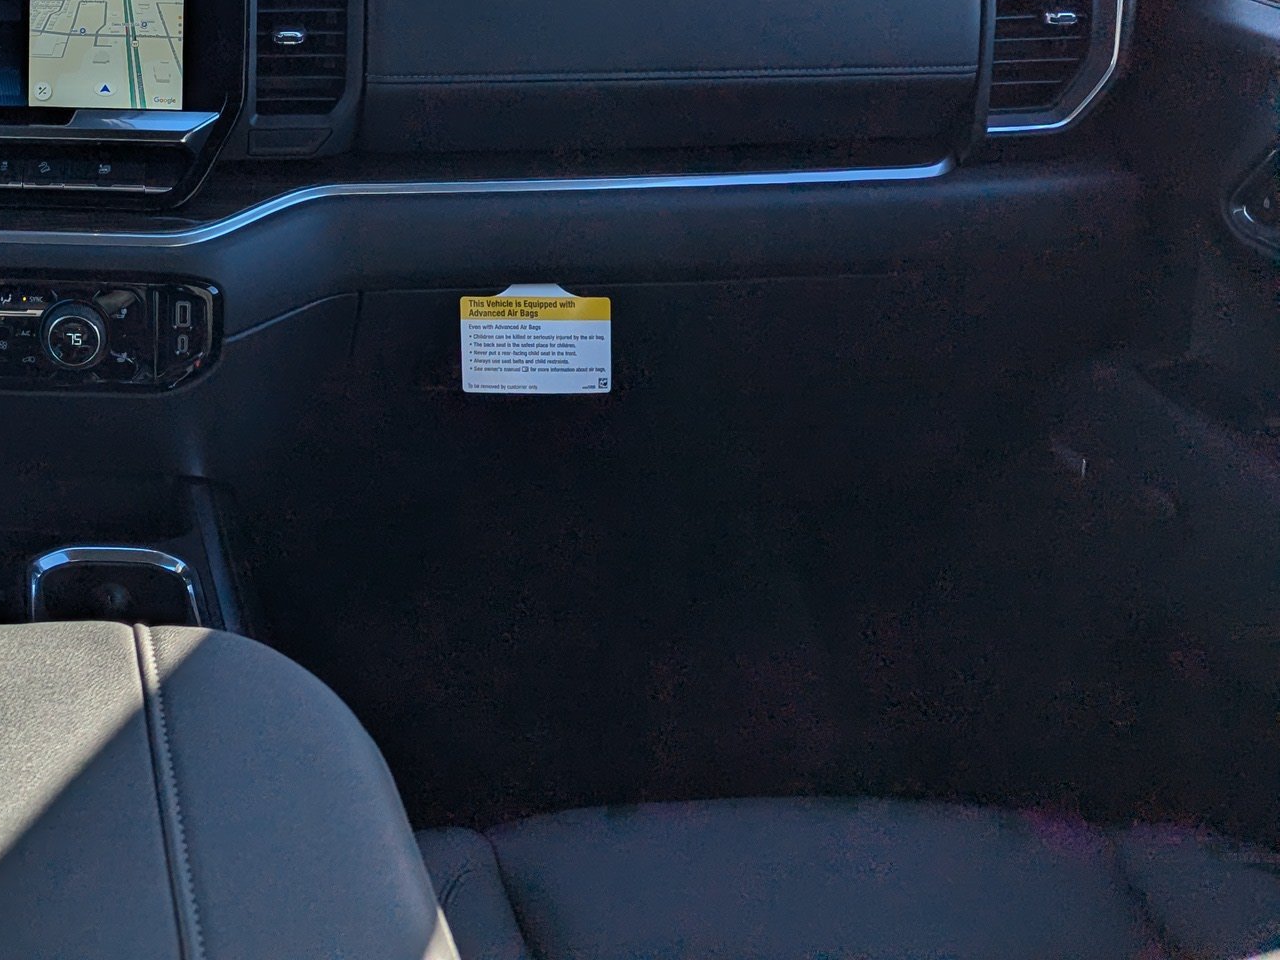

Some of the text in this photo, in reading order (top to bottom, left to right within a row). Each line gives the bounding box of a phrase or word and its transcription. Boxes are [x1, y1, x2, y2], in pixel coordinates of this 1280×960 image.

[153, 96, 176, 105] Google
[469, 300, 576, 309] This Vehicle is Equipped with
[469, 309, 539, 318] Advanced Air Bags
